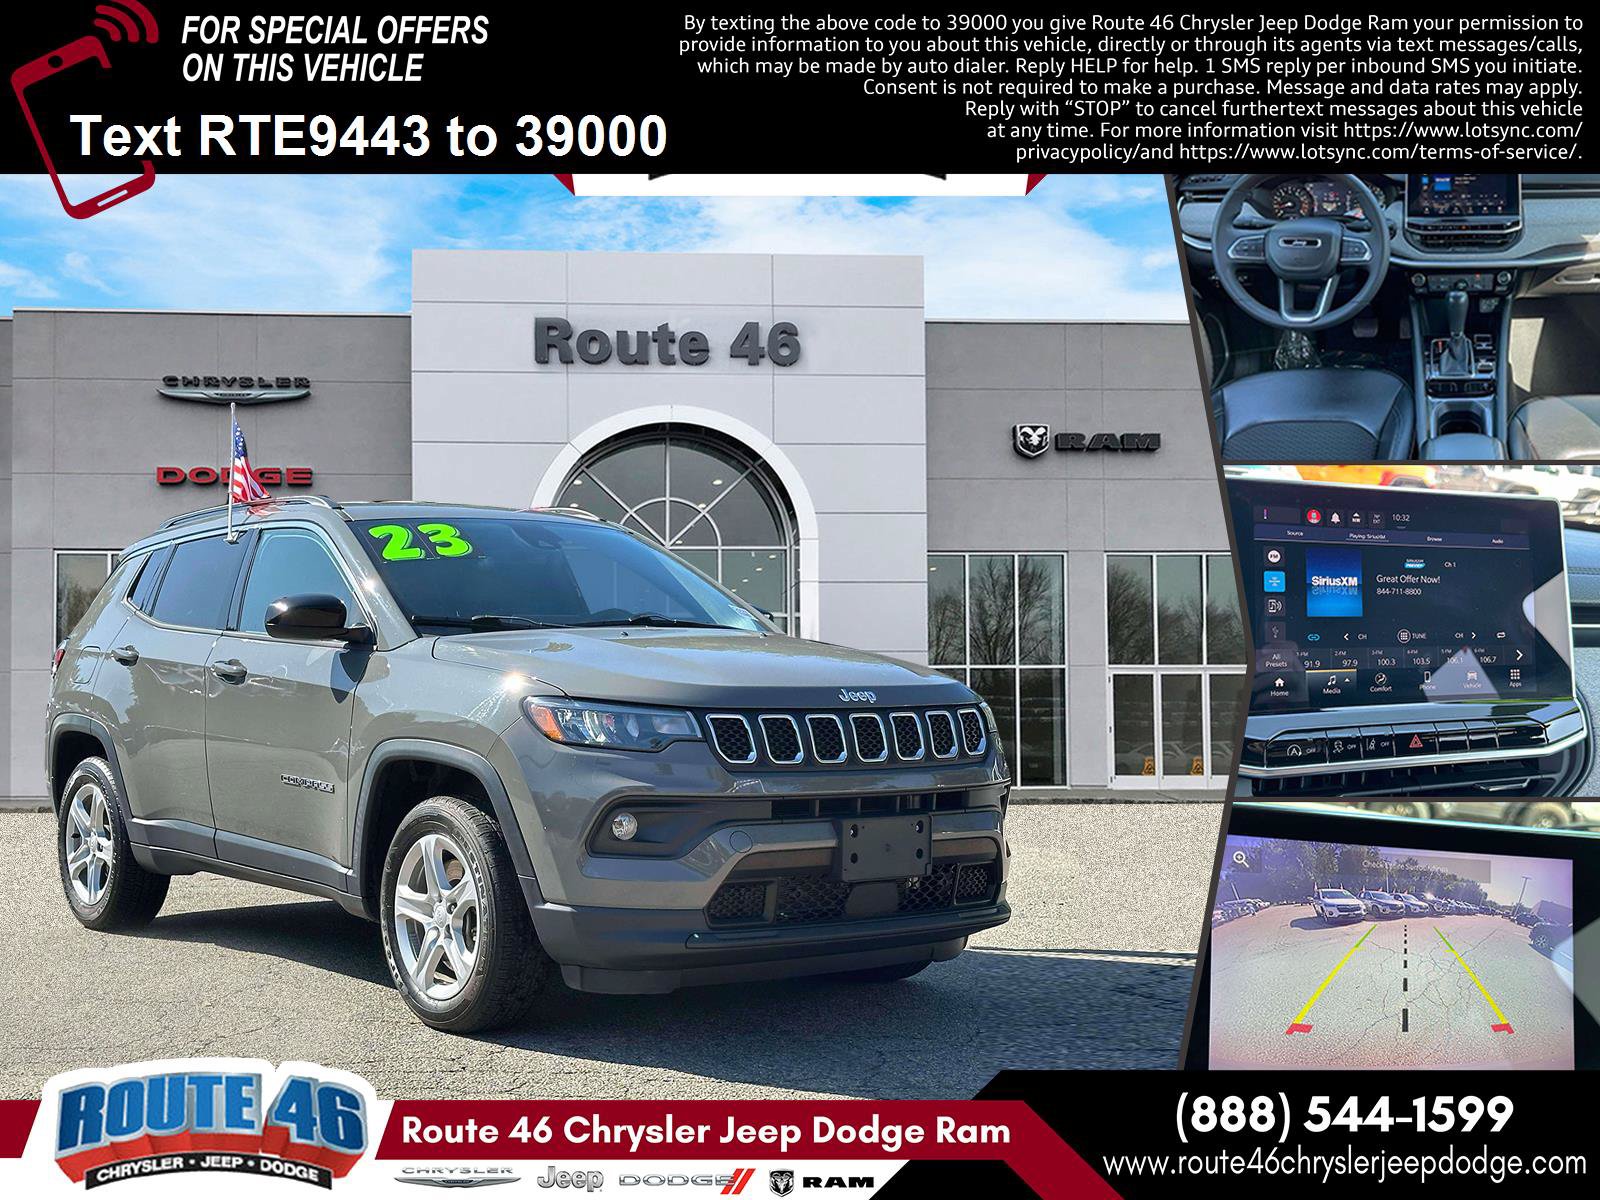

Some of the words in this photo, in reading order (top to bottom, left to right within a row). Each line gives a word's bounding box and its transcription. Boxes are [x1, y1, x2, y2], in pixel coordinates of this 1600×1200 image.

[533, 316, 711, 367] Route
[729, 320, 801, 367] 46
[161, 375, 311, 388] CHRYSLER
[1054, 432, 1162, 452] RAM
[1391, 513, 1411, 522] 10:32
[1286, 529, 1304, 537] Source
[367, 522, 474, 561] 23
[1311, 576, 1359, 586] SiriusXM
[1376, 574, 1398, 583] Great
[1399, 574, 1419, 583] Offer
[1420, 575, 1441, 584] Now!
[1376, 587, 1422, 596] 844-711-8800
[1411, 632, 1427, 640] TUNE
[1265, 660, 1288, 668] Presets
[1303, 660, 1321, 669] 91.9
[1341, 658, 1358, 667] 97.9
[1377, 658, 1396, 666] 100.3
[1412, 657, 1431, 665] 103.5
[1322, 687, 1341, 695] Media
[1369, 685, 1393, 693] Comfort
[838, 688, 877, 704] Jeep
